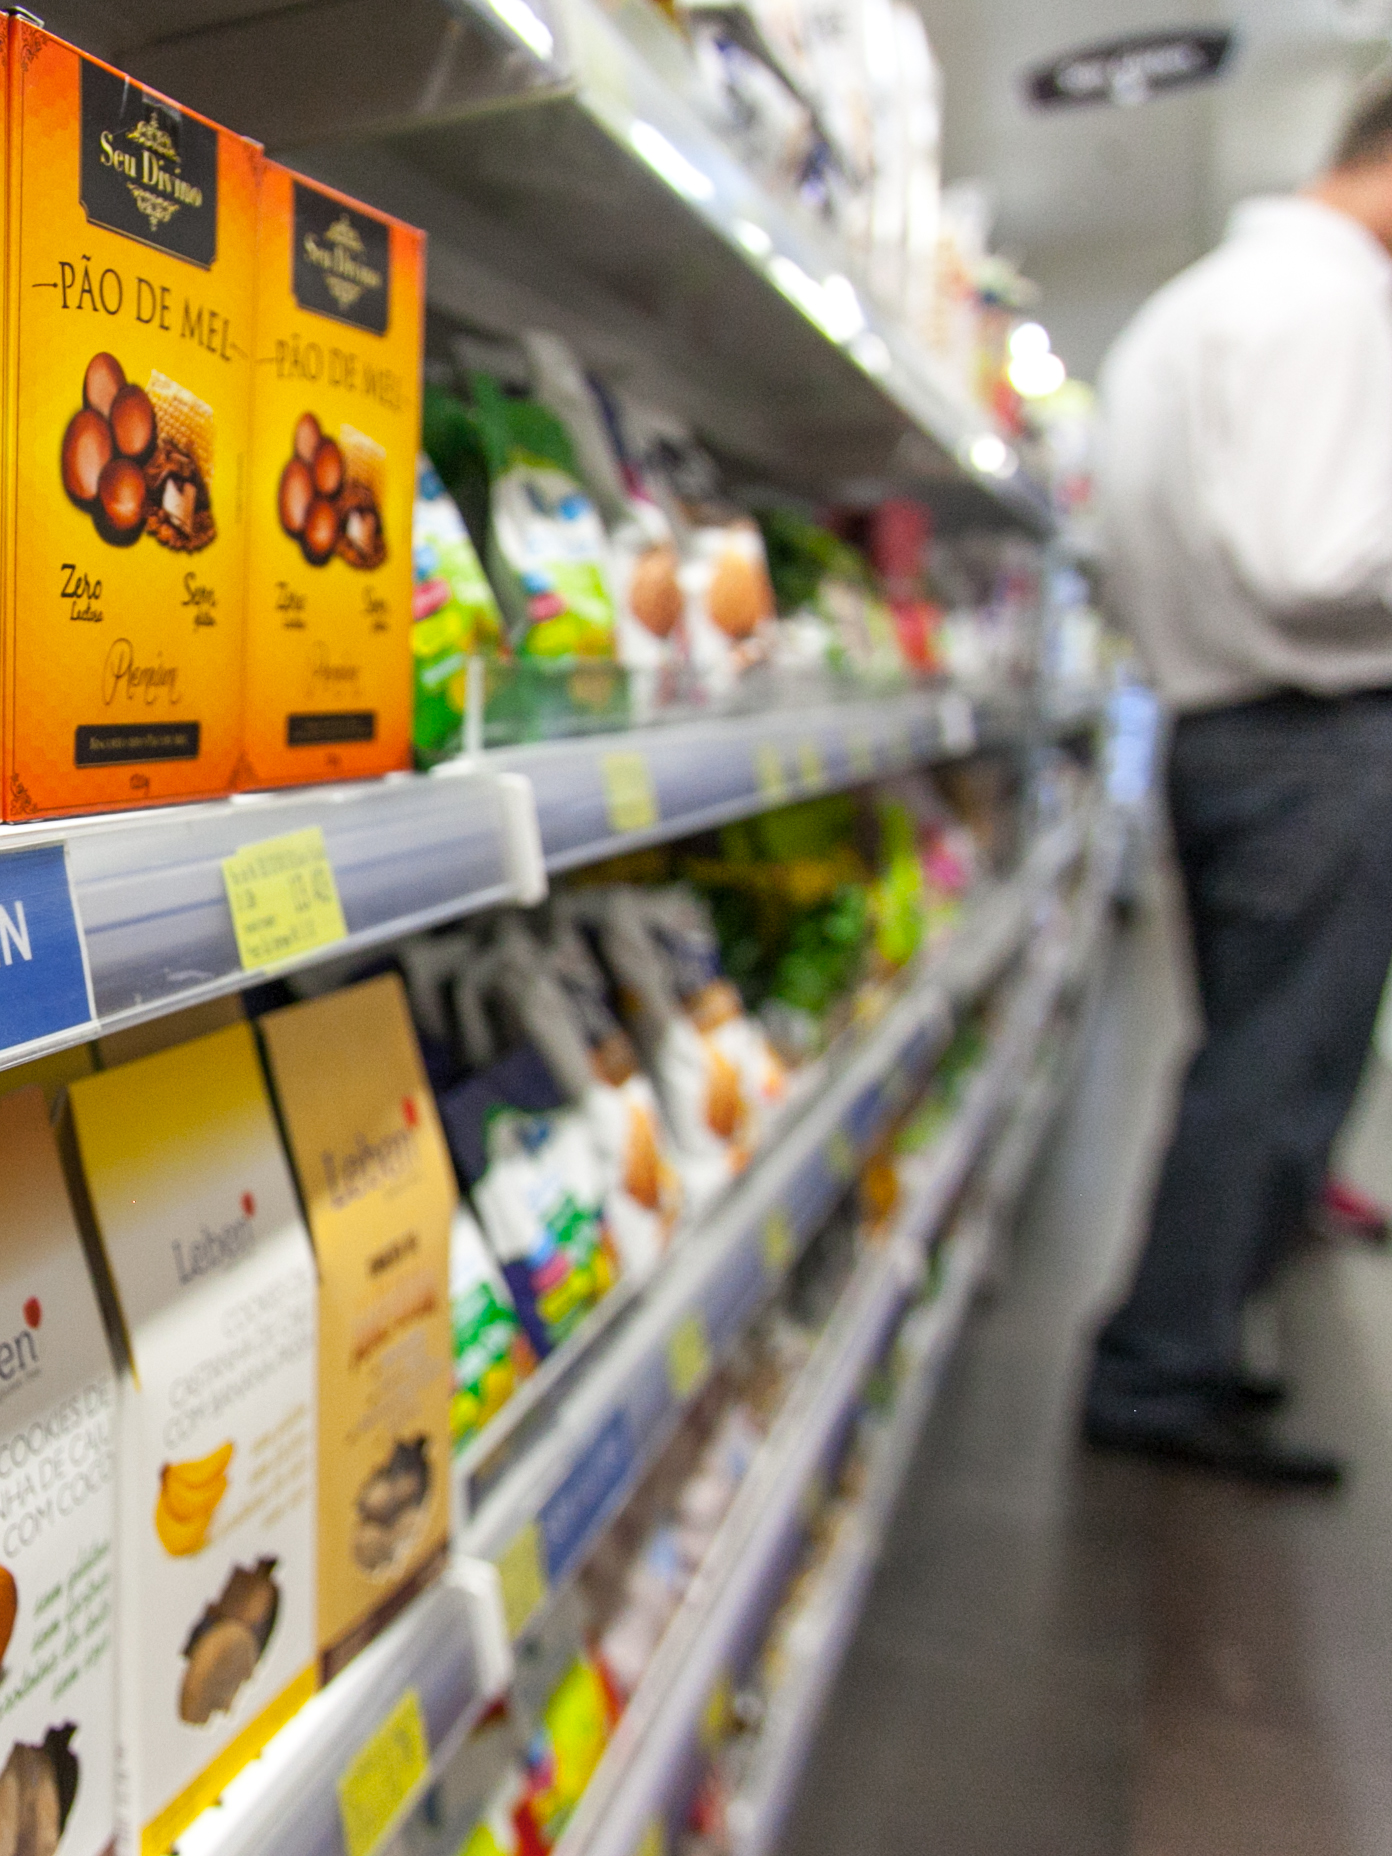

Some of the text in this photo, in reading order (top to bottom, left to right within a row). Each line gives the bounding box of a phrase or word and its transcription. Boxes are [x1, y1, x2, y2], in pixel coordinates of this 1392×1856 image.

[99, 130, 205, 209] Seu Divino
[57, 254, 234, 363] PÃO DE MEL
[60, 563, 103, 600] Zero
[171, 1214, 257, 1285] Leben
